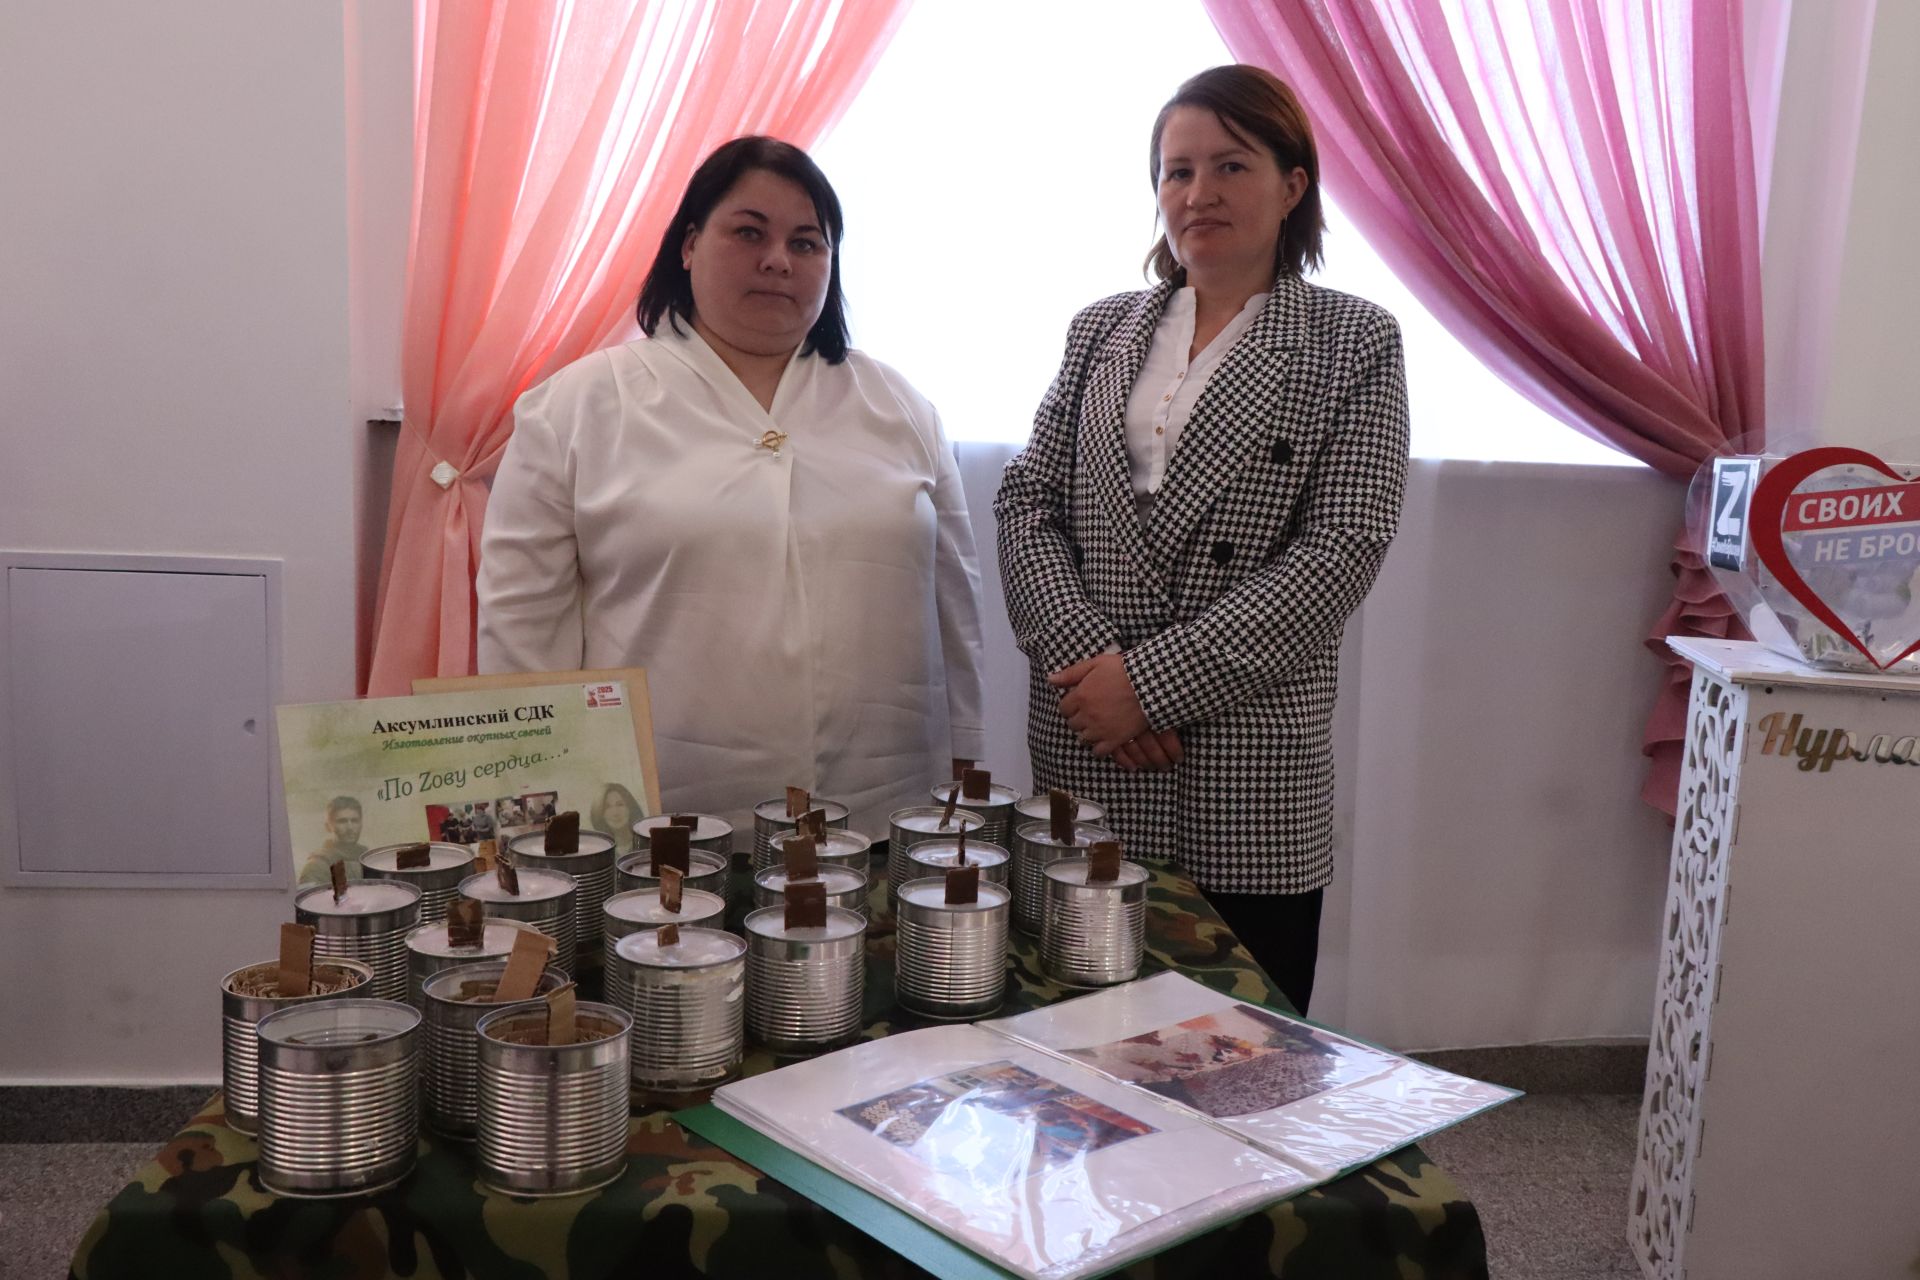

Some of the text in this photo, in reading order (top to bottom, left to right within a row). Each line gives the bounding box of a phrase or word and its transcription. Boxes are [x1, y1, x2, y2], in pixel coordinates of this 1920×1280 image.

[1798, 491, 1905, 524] СВОИХ
[1815, 532, 1920, 561] НЕ БРО
[372, 704, 555, 735] Аксумлинский СДК
[382, 725, 552, 751] Изготовление окопных свечей
[377, 777, 413, 801] «По
[419, 767, 466, 792] Zову
